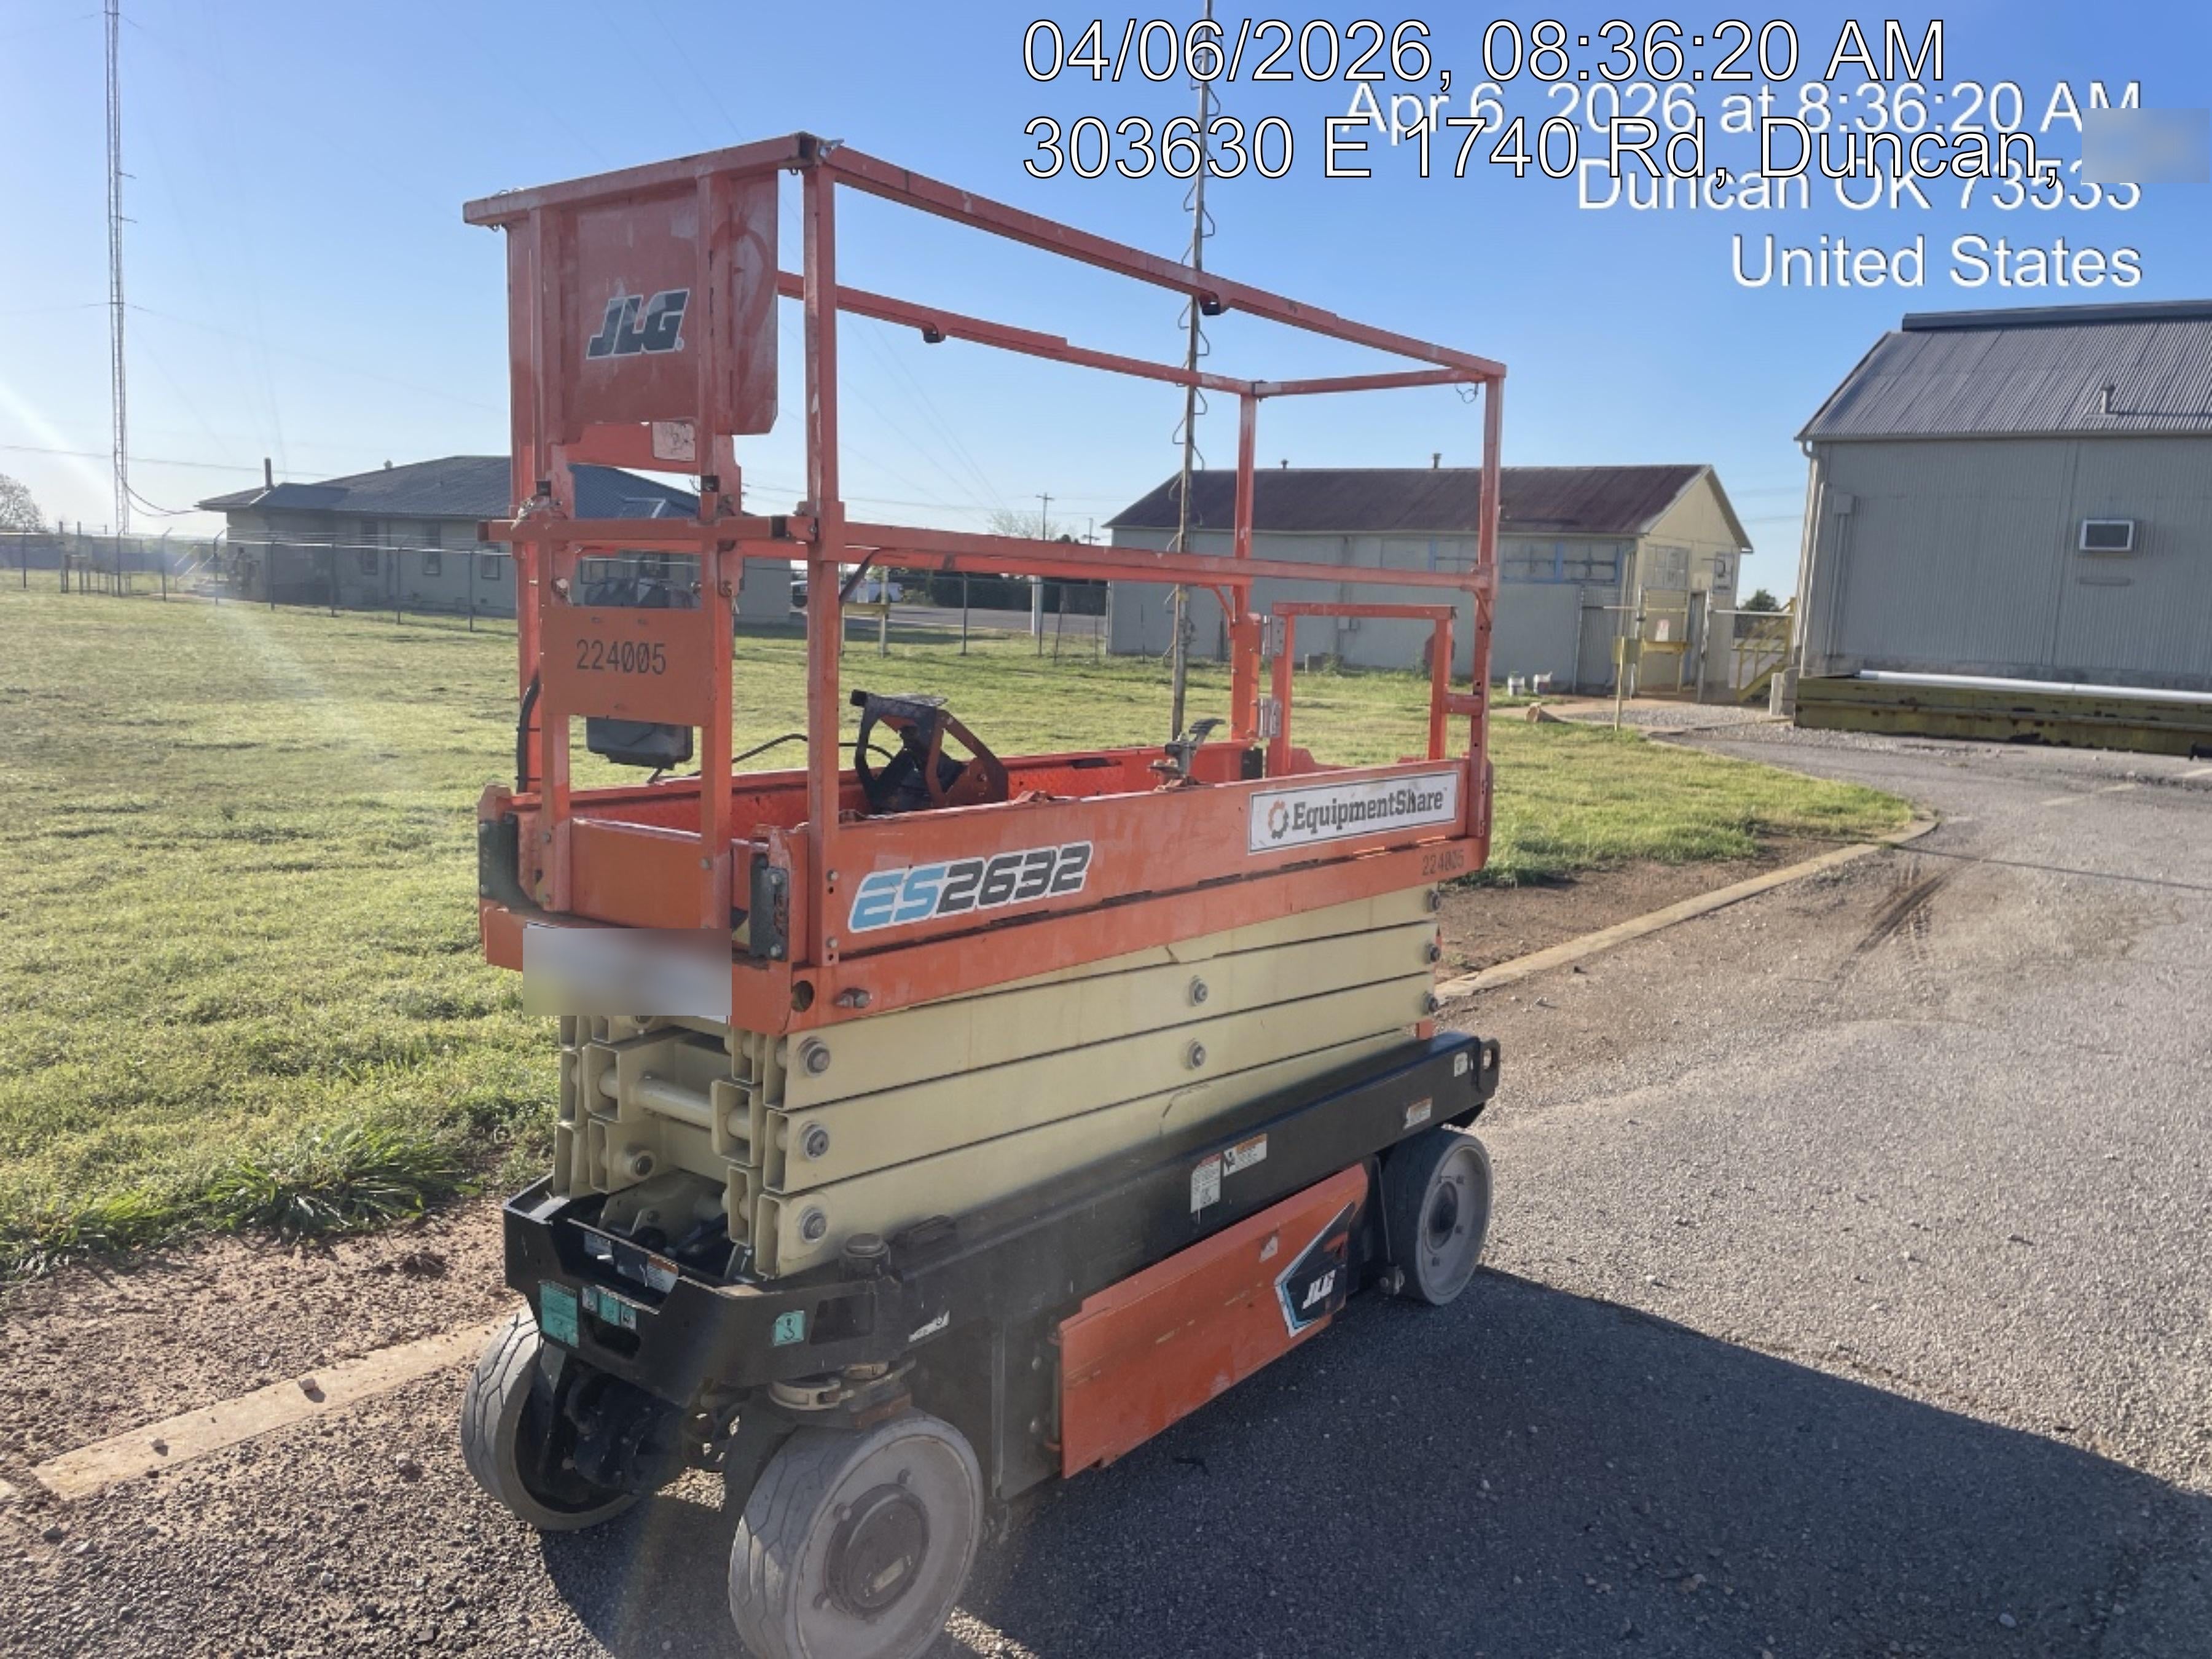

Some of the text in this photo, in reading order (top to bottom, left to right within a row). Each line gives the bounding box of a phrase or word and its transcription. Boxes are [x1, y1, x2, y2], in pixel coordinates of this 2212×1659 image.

[586, 289, 689, 359] JLG
[576, 639, 666, 675] 224005
[1292, 789, 1443, 834] EquipmentShare
[849, 841, 1092, 932] ES2632
